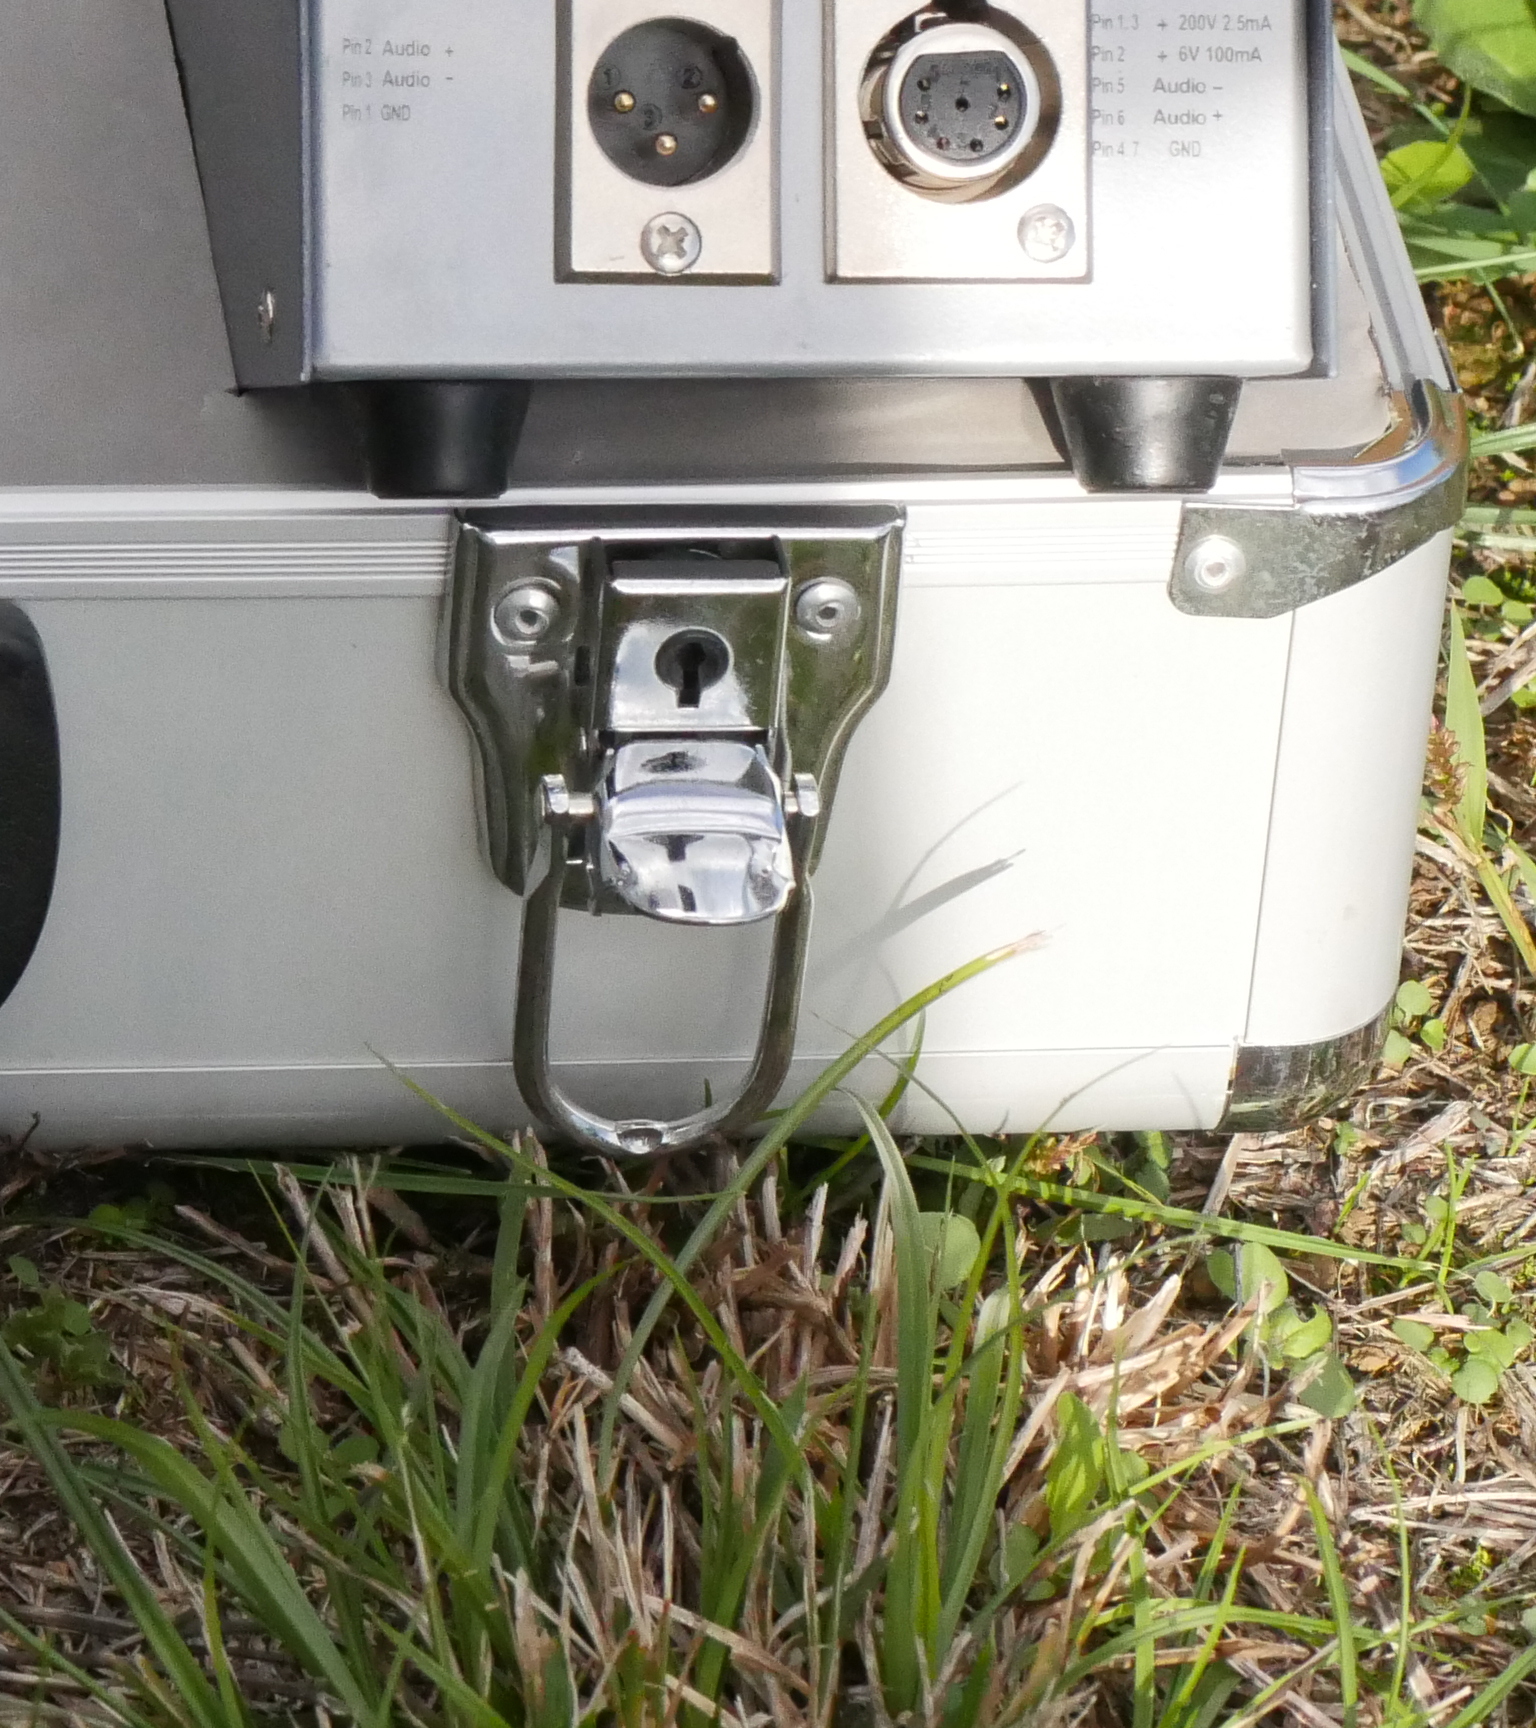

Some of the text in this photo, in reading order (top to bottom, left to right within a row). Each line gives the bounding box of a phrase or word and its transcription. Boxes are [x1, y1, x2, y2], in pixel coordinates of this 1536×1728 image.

[1091, 13, 1113, 31] Pin
[1178, 13, 1217, 31] 200V
[381, 39, 431, 57] Audio
[1091, 45, 1114, 63] Pin
[1117, 45, 1126, 63] 2
[1178, 45, 1200, 63] 6V
[1205, 46, 1263, 63] 100mA
[381, 69, 431, 88] Audio
[1091, 76, 1114, 94] Pin
[1116, 77, 1125, 94] 5
[1152, 76, 1207, 94] Audio
[380, 103, 411, 122] GND
[1091, 108, 1114, 126] Pin
[1153, 108, 1207, 126] Audio
[1091, 140, 1114, 158] Pin
[1169, 140, 1202, 158] GND
